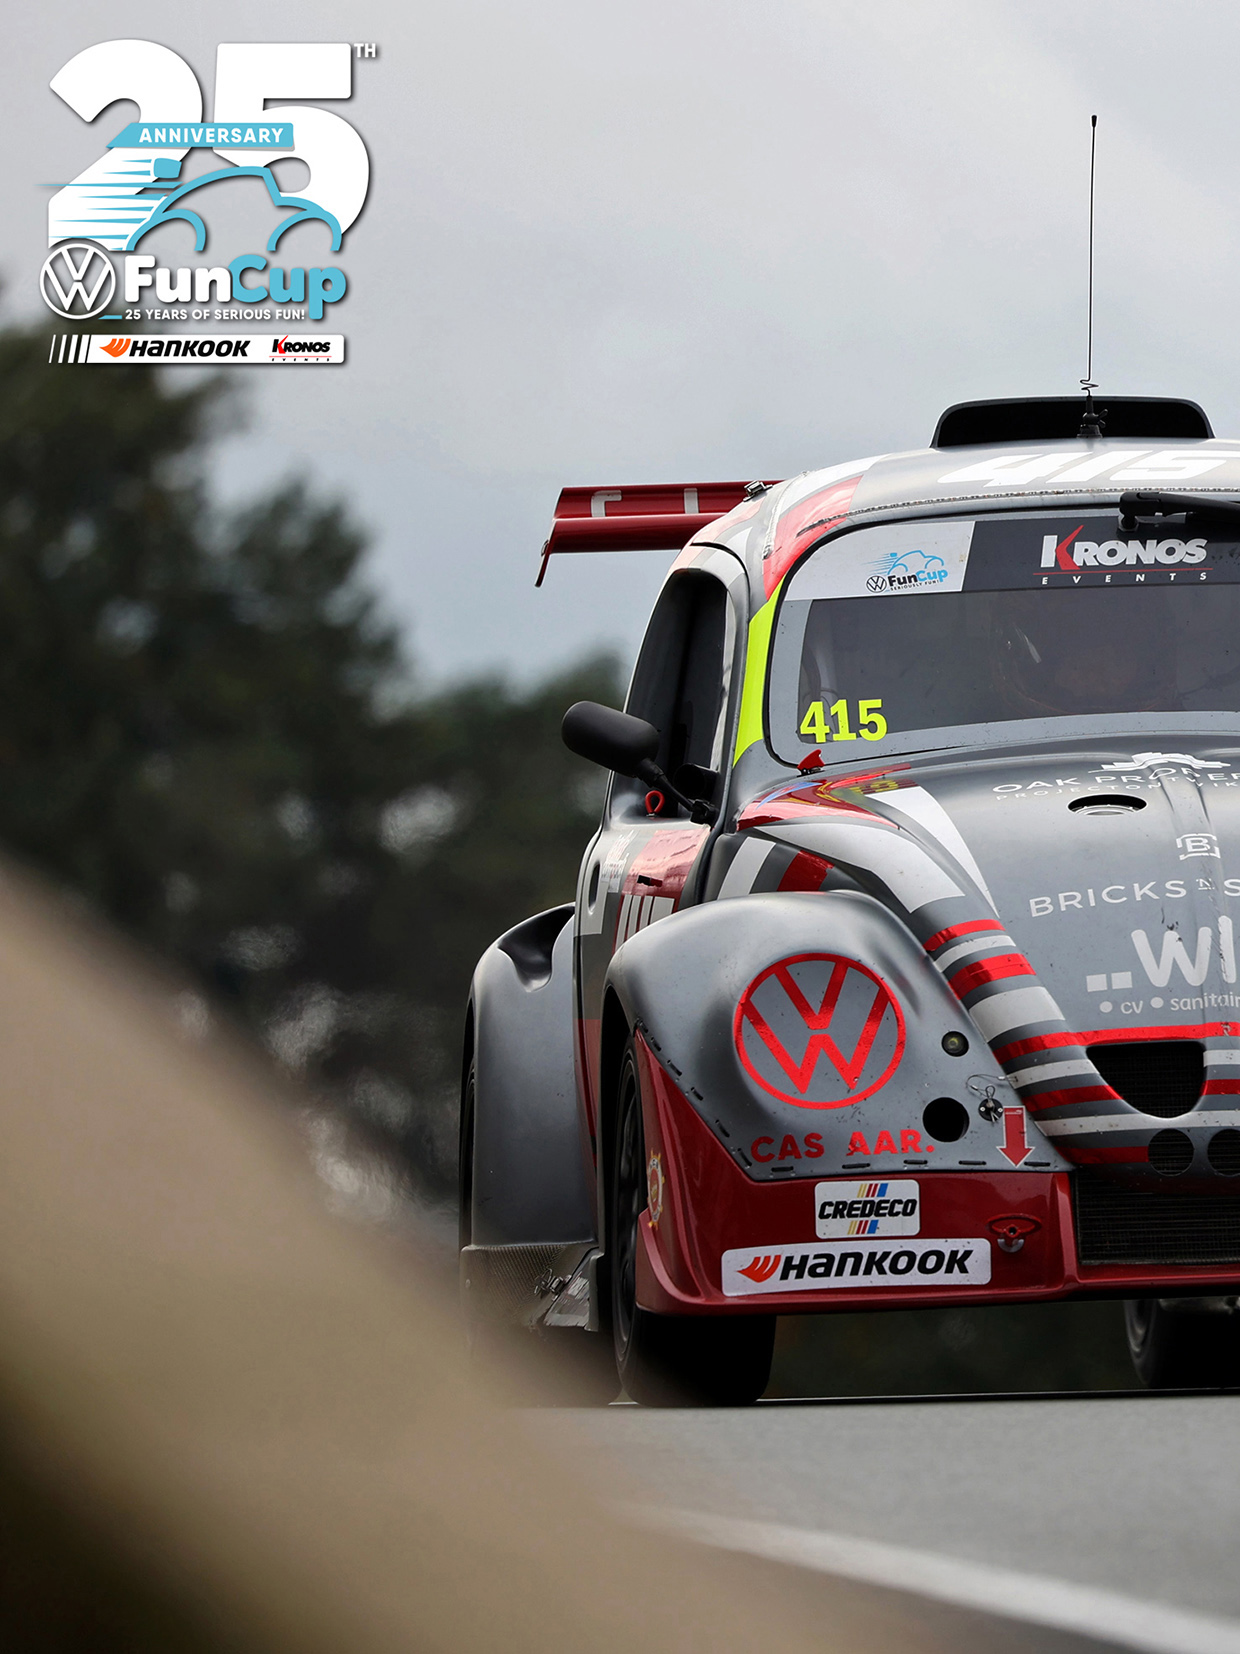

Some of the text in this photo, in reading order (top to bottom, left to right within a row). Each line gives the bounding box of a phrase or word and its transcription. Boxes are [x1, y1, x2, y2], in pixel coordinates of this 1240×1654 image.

[1040, 524, 1209, 570] KRONOS
[888, 569, 948, 587] FunCup
[1041, 572, 1208, 585] EVENTS
[800, 699, 888, 743] 415
[993, 777, 1081, 792] OAK
[1029, 879, 1188, 917] BRICKS
[750, 1132, 825, 1163] CAS
[818, 1199, 917, 1220] CREDECO
